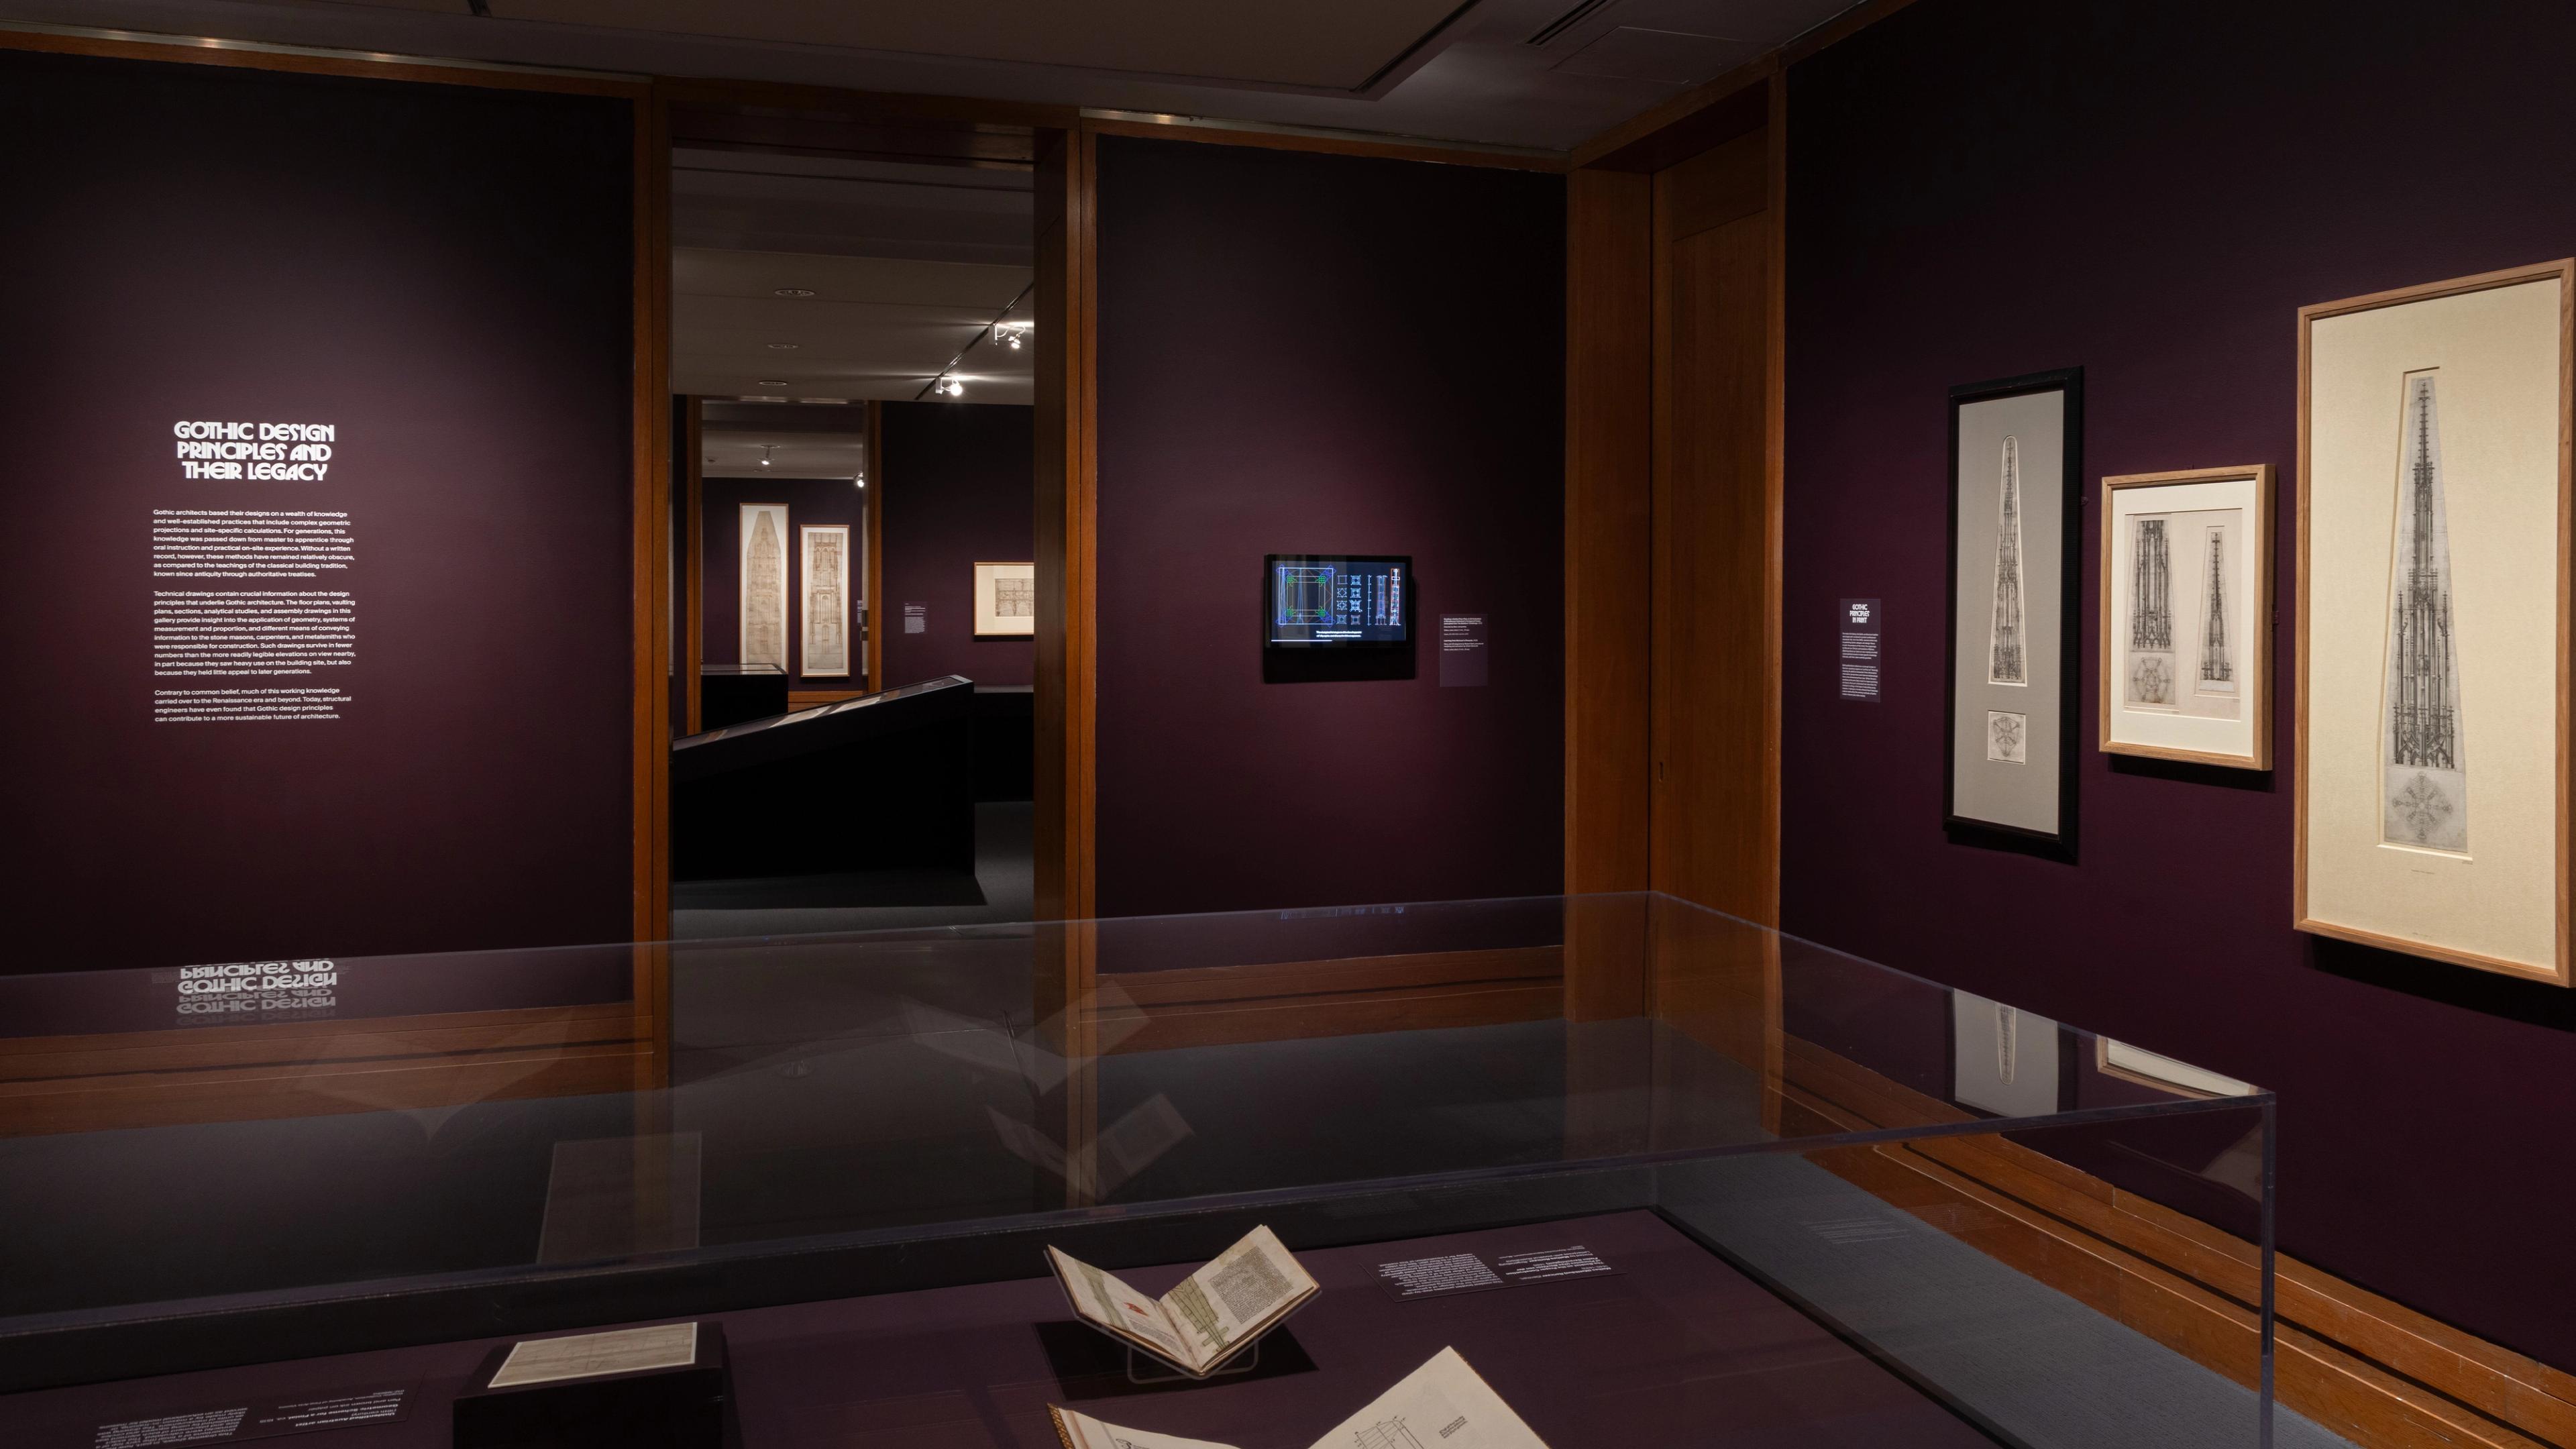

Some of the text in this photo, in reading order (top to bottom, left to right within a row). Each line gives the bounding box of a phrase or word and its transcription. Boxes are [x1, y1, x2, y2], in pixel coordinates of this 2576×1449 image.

[174, 421, 335, 442] GOTHIC DESIGN
[177, 441, 332, 462] PRINCIPLES AND
[182, 461, 328, 481] THEIR LEGACY
